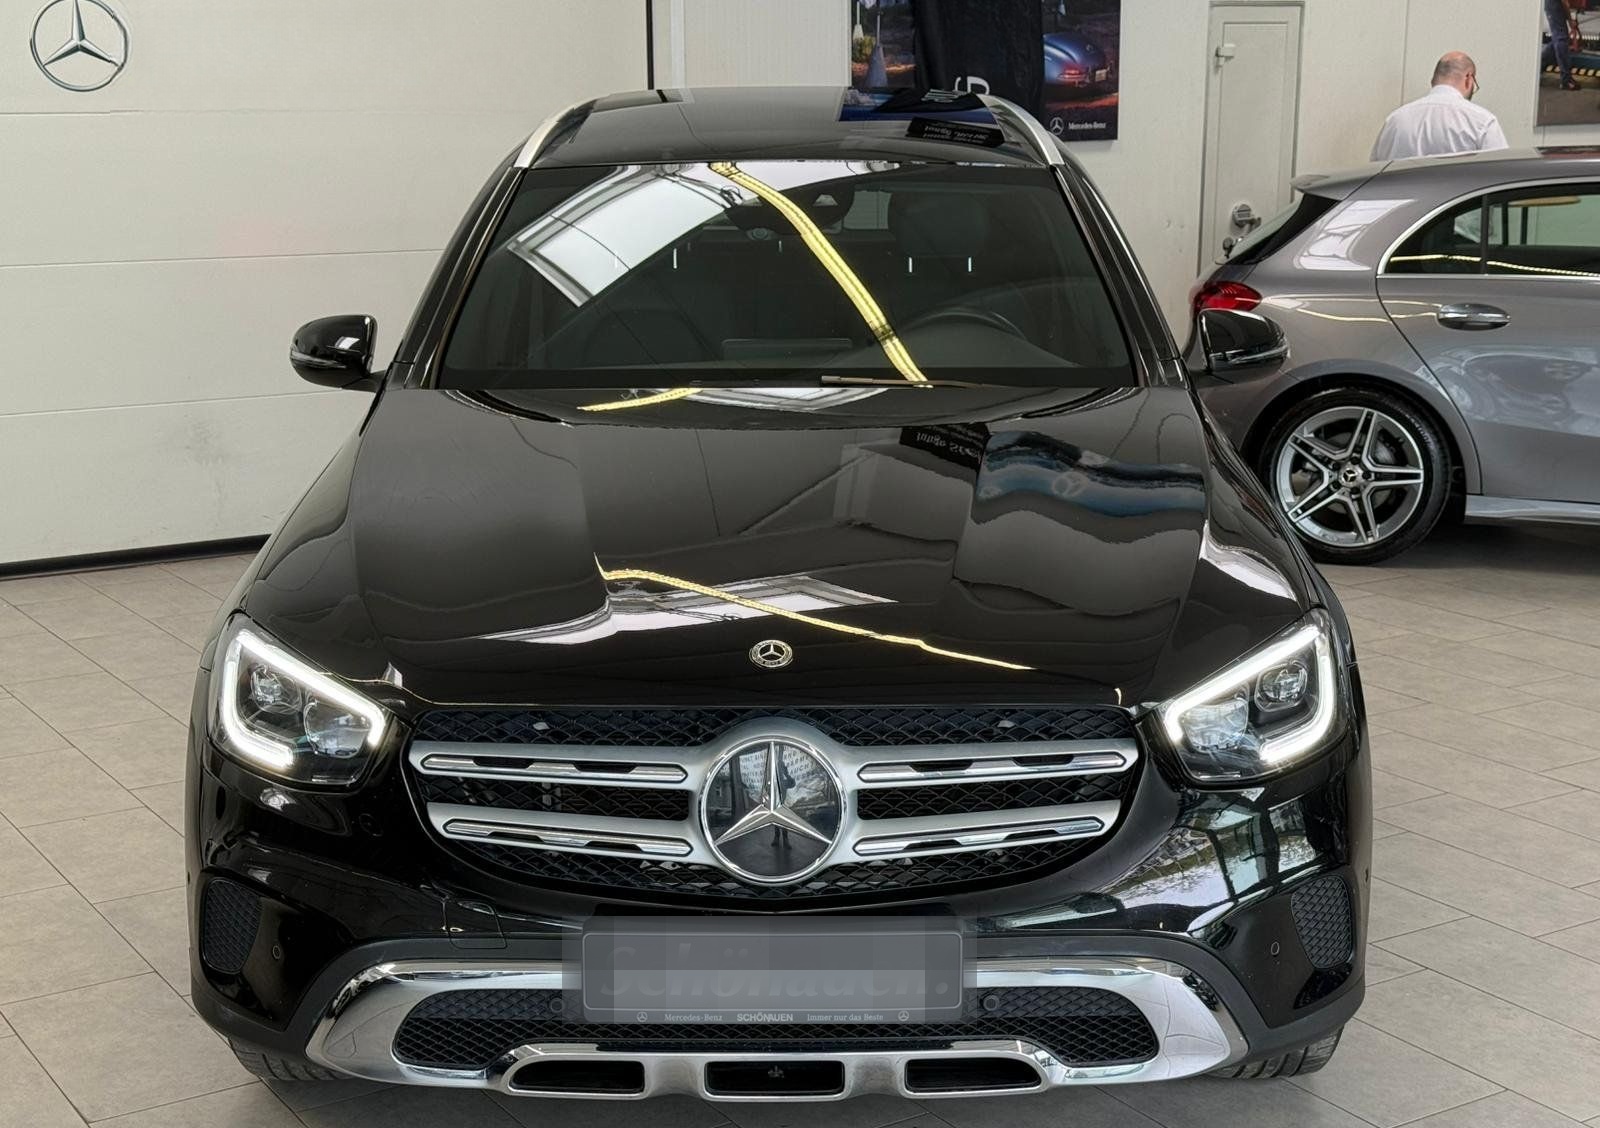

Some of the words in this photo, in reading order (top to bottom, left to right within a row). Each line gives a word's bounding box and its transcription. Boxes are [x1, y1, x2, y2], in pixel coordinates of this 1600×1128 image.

[664, 1013, 723, 1022] Mercedes-Benz
[736, 1012, 794, 1022] SCHÖNAUEN
[807, 1013, 832, 1022] Immer
[834, 1014, 847, 1022] nur
[848, 1013, 862, 1022] das
[863, 1013, 884, 1022] Beste
